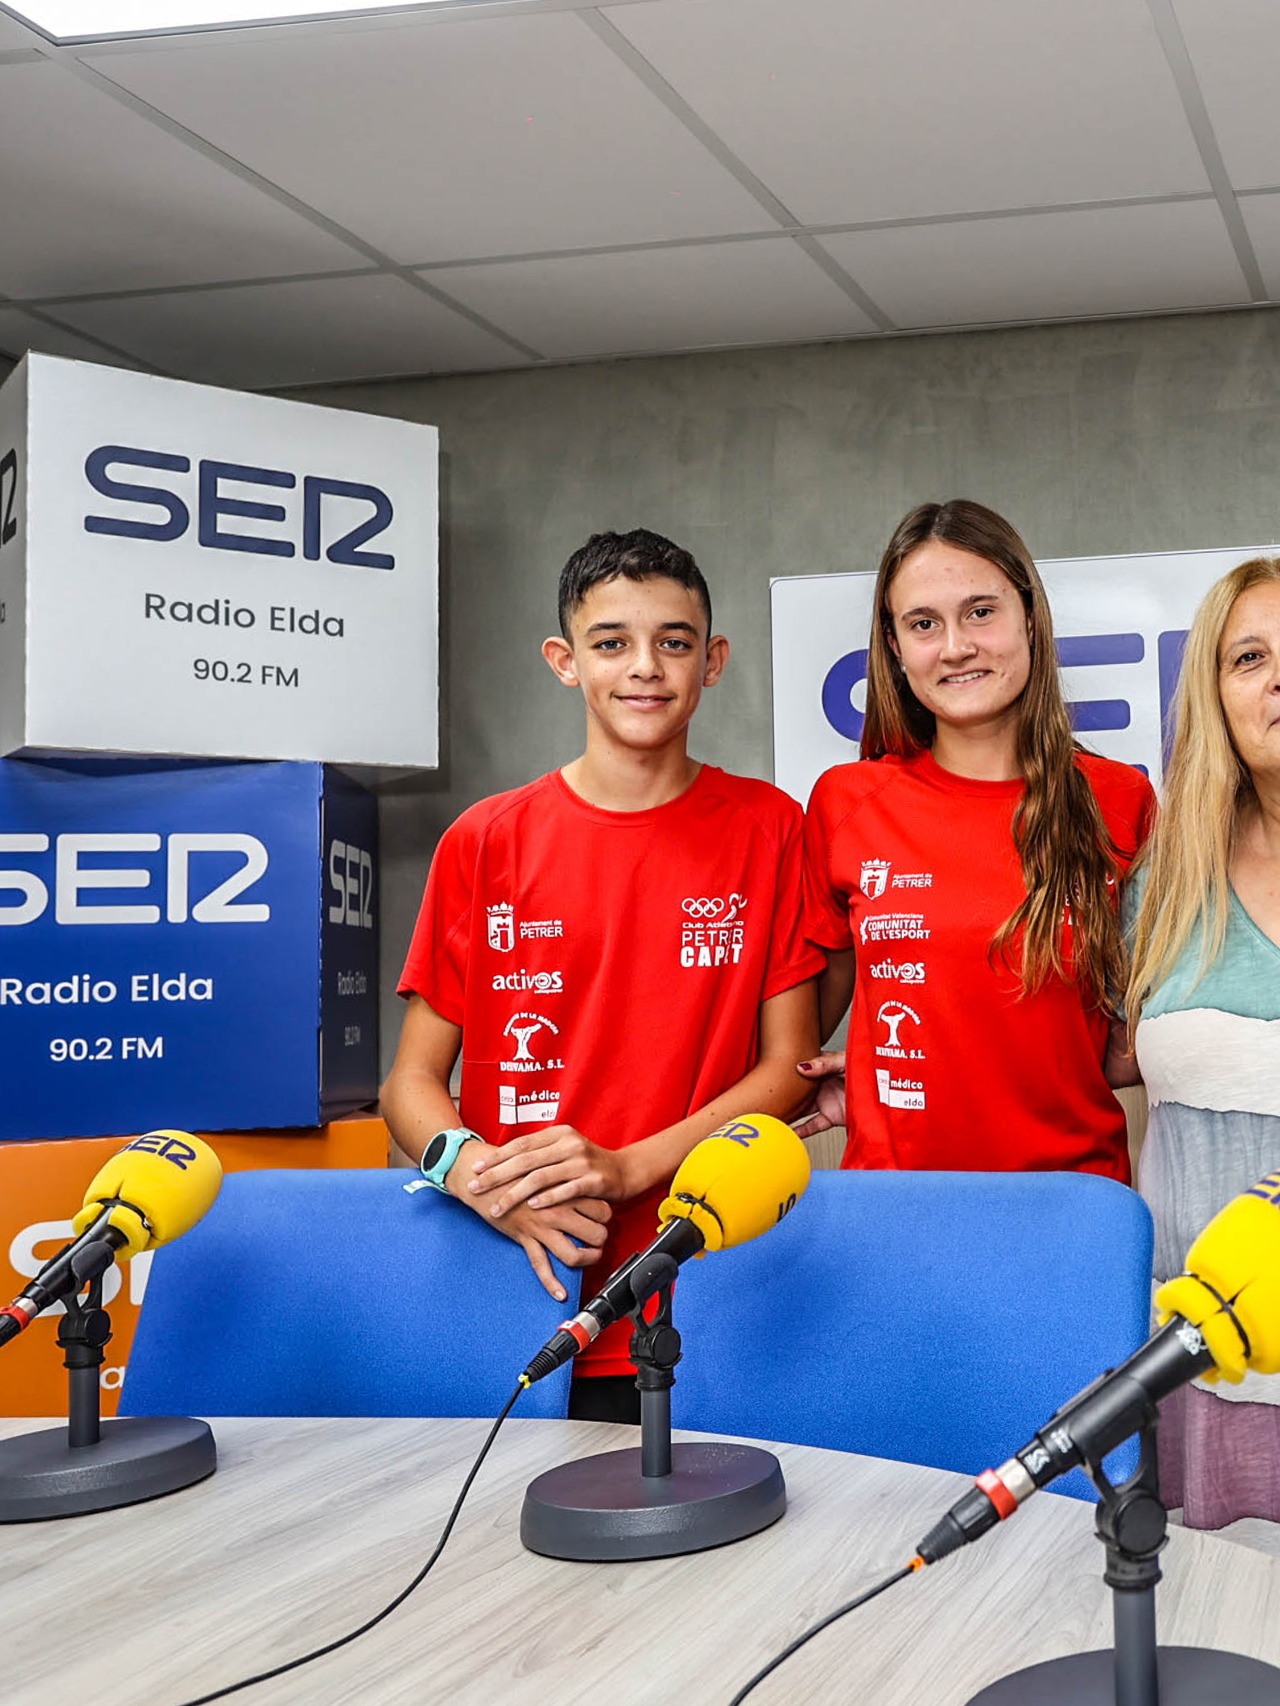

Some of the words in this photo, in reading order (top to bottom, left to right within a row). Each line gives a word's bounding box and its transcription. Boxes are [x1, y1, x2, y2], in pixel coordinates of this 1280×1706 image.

[84, 445, 395, 570] SER
[144, 593, 256, 629] Radio
[269, 607, 345, 637] Elda
[193, 659, 252, 683] 90.2
[261, 666, 299, 687] FM
[0, 833, 270, 925] SER
[329, 839, 373, 928] SER
[891, 878, 932, 888] PETRER
[520, 926, 563, 939] PETRER
[868, 919, 924, 932] COMUNITAT
[871, 930, 881, 941] DE
[882, 929, 931, 940] L'ESPORT
[681, 928, 744, 946] PETRR
[680, 943, 744, 968] CAPT
[0, 973, 117, 1005] Radio
[131, 973, 213, 1001] Elda
[49, 1037, 113, 1061] 90.2
[121, 1036, 164, 1059] FM
[890, 1078, 924, 1090] médico
[519, 1090, 560, 1103] médico
[904, 1098, 924, 1107] elda
